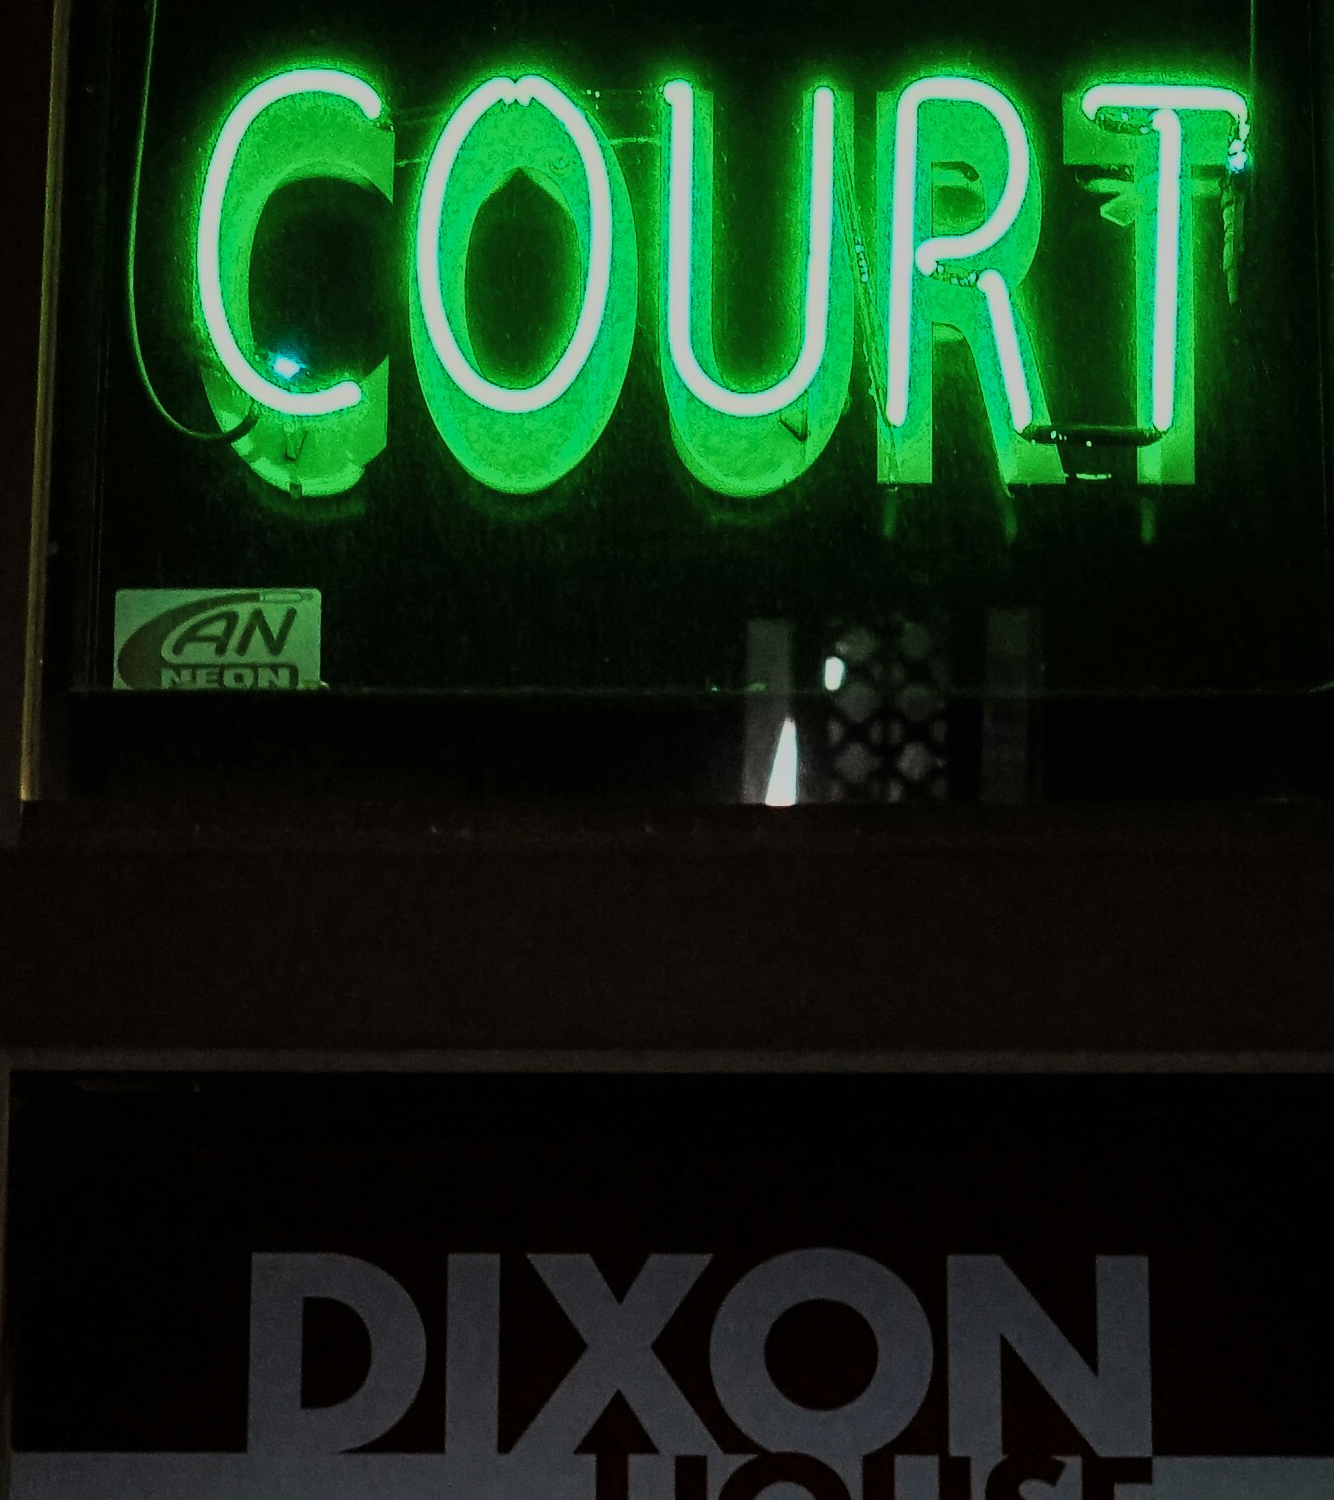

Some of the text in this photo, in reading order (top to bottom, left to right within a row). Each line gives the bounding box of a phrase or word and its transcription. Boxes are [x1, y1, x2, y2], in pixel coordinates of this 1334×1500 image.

[192, 68, 1252, 495] COURT
[161, 665, 300, 689] NEON
[246, 1246, 1154, 1455] DIXON
